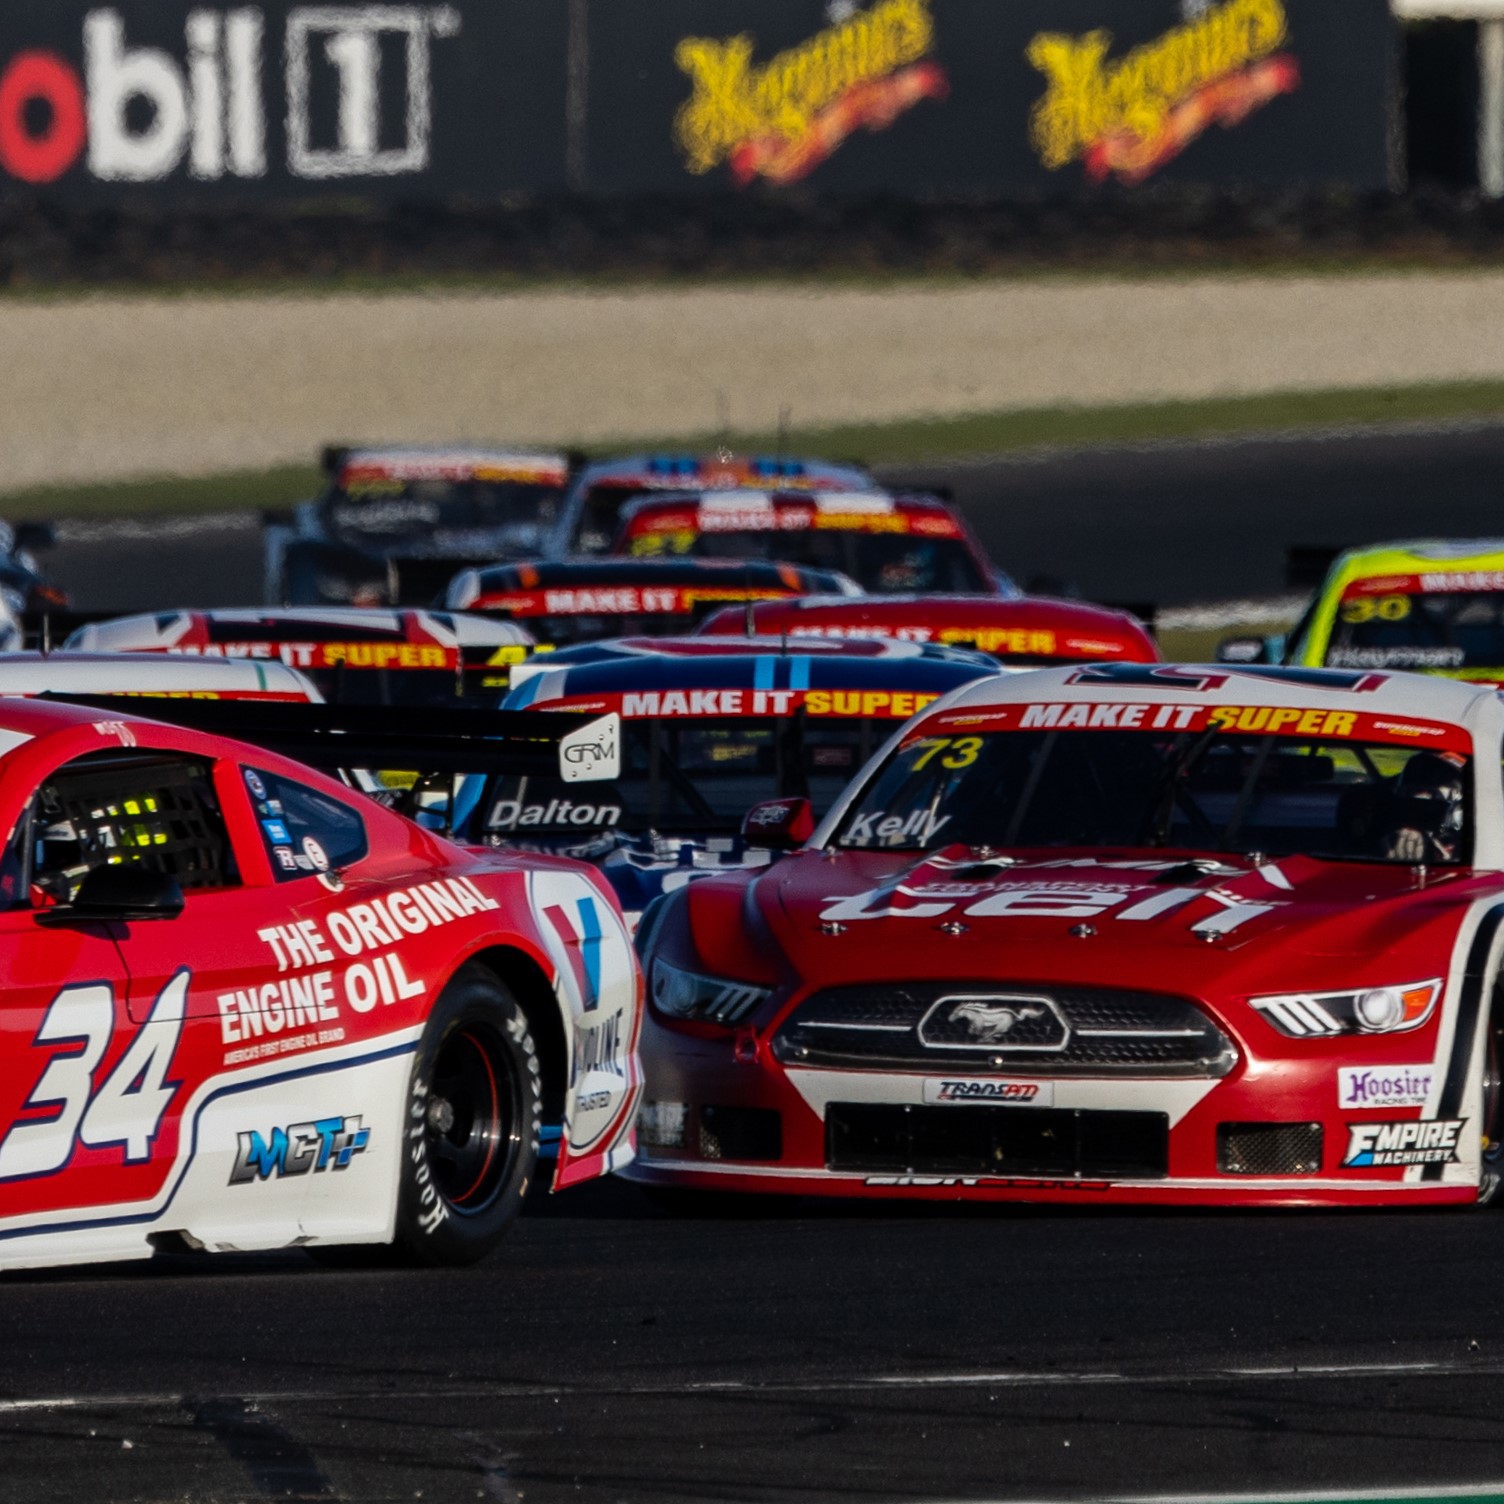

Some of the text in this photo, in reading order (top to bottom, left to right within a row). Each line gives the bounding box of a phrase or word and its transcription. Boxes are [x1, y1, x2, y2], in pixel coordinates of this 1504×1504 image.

[323, 643, 446, 667] SUPER
[622, 690, 742, 716] MAKE
[752, 690, 795, 714] IT
[1018, 704, 1358, 736] MAKE IT SUPER
[564, 741, 615, 763] GRM
[912, 737, 984, 772] 73
[488, 799, 622, 827] Dalton
[846, 809, 952, 848] Kelly
[257, 876, 500, 972] THE ORIGINAL
[217, 953, 426, 1044] ENGINE OIL
[1346, 1069, 1431, 1103] Hoosier
[1344, 1121, 1464, 1166] EMPIRE
